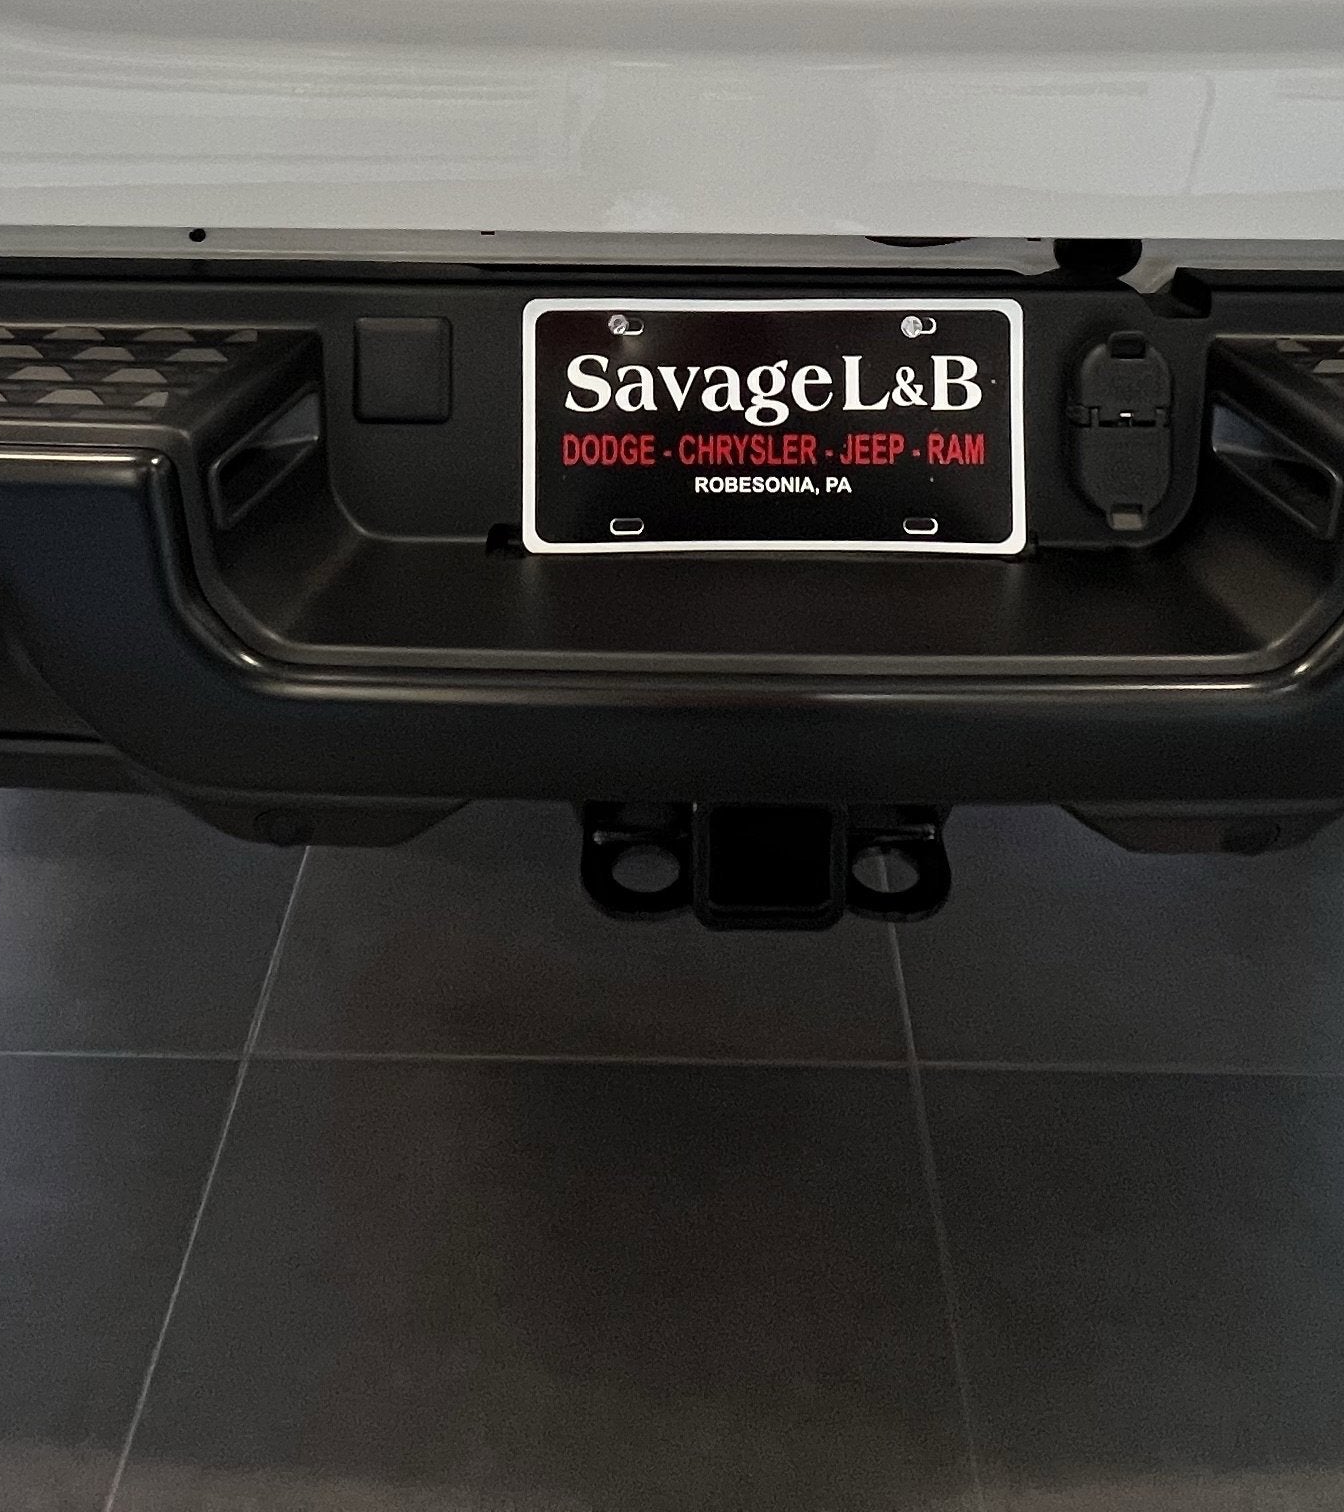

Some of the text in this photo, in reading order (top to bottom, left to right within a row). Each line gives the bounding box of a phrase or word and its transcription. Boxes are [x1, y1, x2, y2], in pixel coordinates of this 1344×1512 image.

[564, 354, 982, 427] Savage L&B
[562, 434, 656, 466] DODGE
[678, 434, 818, 466] CHRYSLER
[838, 434, 906, 466] JEEP
[927, 434, 985, 466] RAM
[694, 476, 852, 496] ROBESONIA, PA
